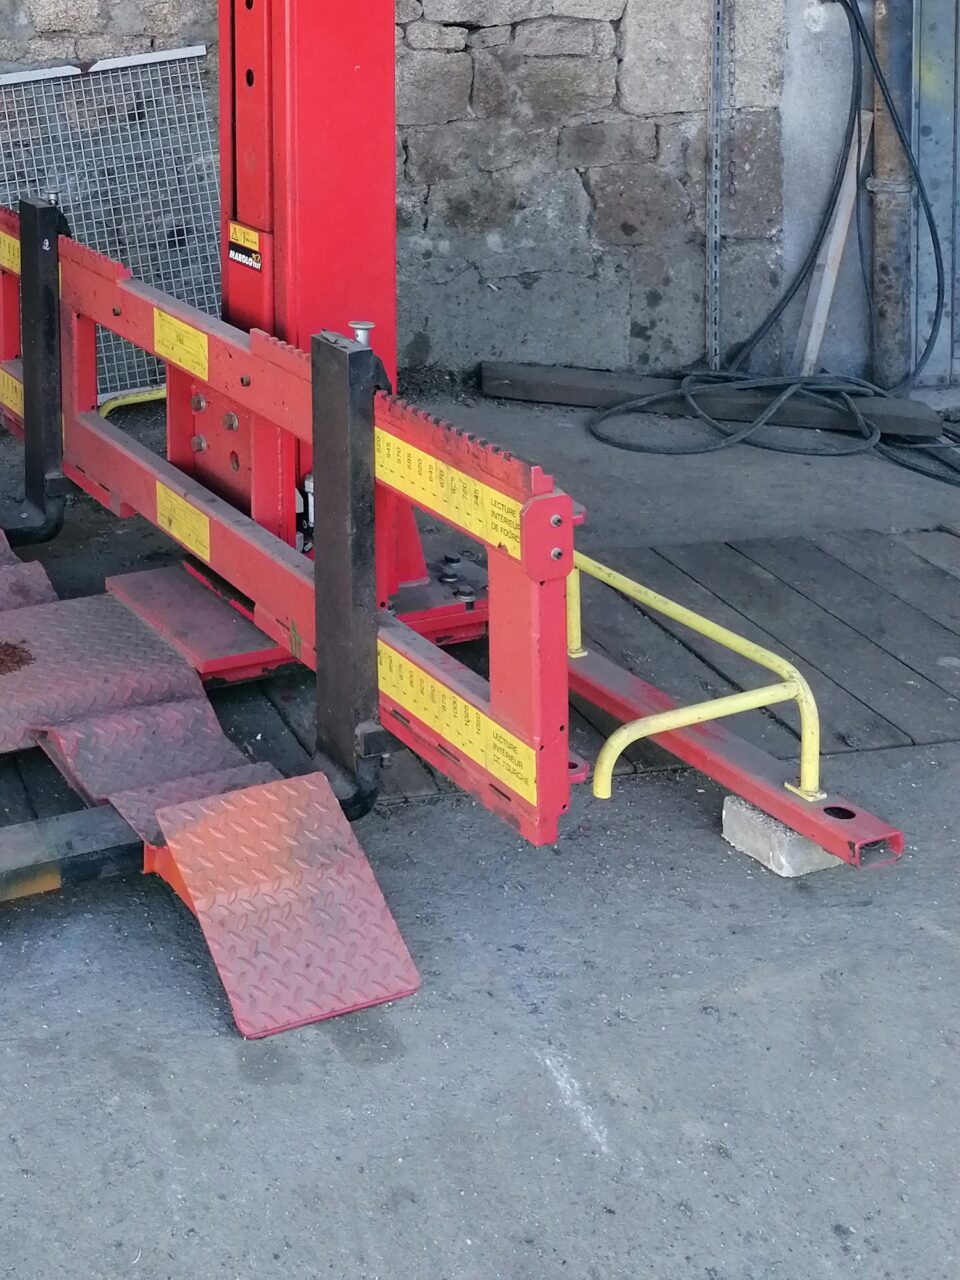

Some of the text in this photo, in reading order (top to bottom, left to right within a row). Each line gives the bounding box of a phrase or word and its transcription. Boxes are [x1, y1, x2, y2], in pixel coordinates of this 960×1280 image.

[491, 498, 516, 518] LECTURE
[491, 522, 499, 532] DE
[493, 731, 518, 754] LECTURE
